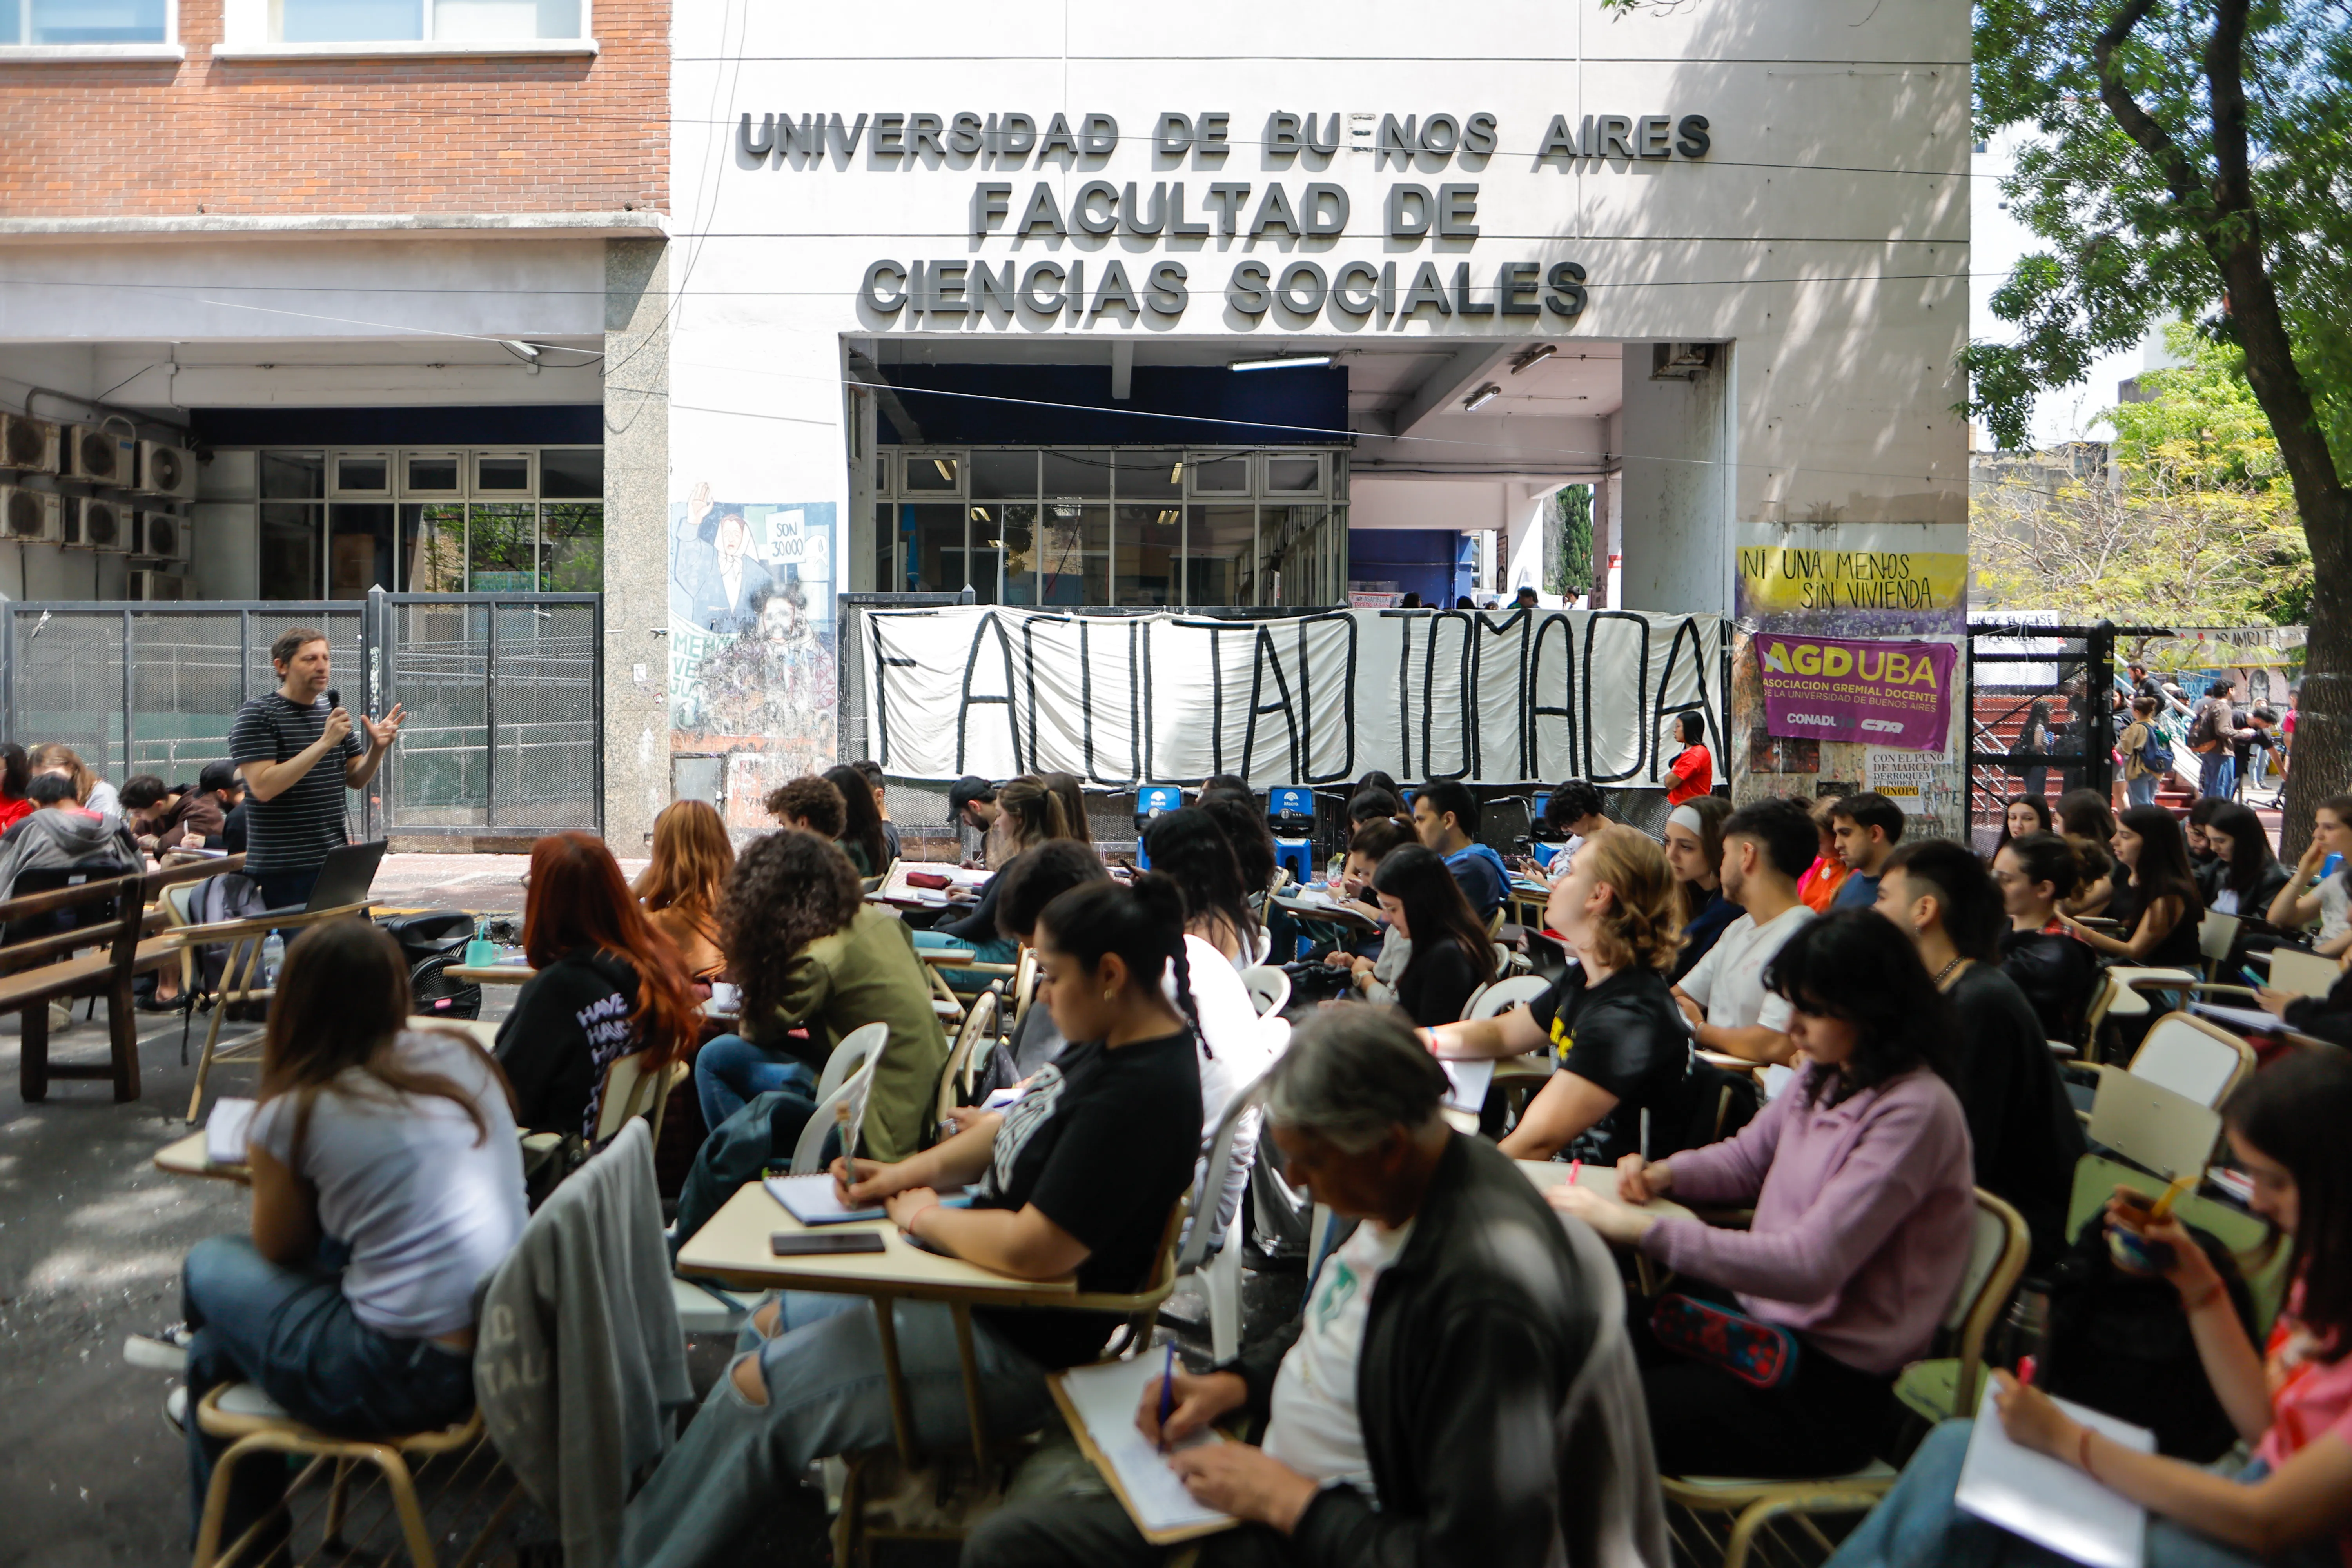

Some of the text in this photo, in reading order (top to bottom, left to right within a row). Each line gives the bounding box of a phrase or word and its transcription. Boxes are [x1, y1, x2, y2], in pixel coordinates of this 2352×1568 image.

[741, 111, 1118, 156] UNIVERSIDAD
[1160, 112, 1230, 154] DE
[1537, 114, 1710, 157] AIRES
[975, 181, 1480, 235] FACULTAD DE
[864, 260, 1588, 315] CIENCIAS SOCIALES
[777, 521, 797, 537] SON
[771, 538, 803, 557] 30000
[1782, 550, 1824, 579] UNA
[1836, 552, 1909, 580] MENOS
[1847, 577, 1932, 609] VIVIENDA
[1762, 642, 1937, 689] AGD UBA
[869, 608, 1725, 785] FACULTAD TOMADA
[1763, 678, 1938, 703] ASOCIACION GREMIAL DOCENTE
[1788, 690, 1851, 702] UNIVERSIDAD
[1853, 695, 1866, 704] DE
[1869, 697, 1907, 709] BUENOS
[1909, 702, 1937, 713] AIRES
[1860, 718, 1904, 734] CTA
[1873, 754, 1895, 763] CON
[1898, 754, 1913, 762] EL
[1873, 764, 1889, 772] DE
[576, 992, 628, 1029] HAVE
